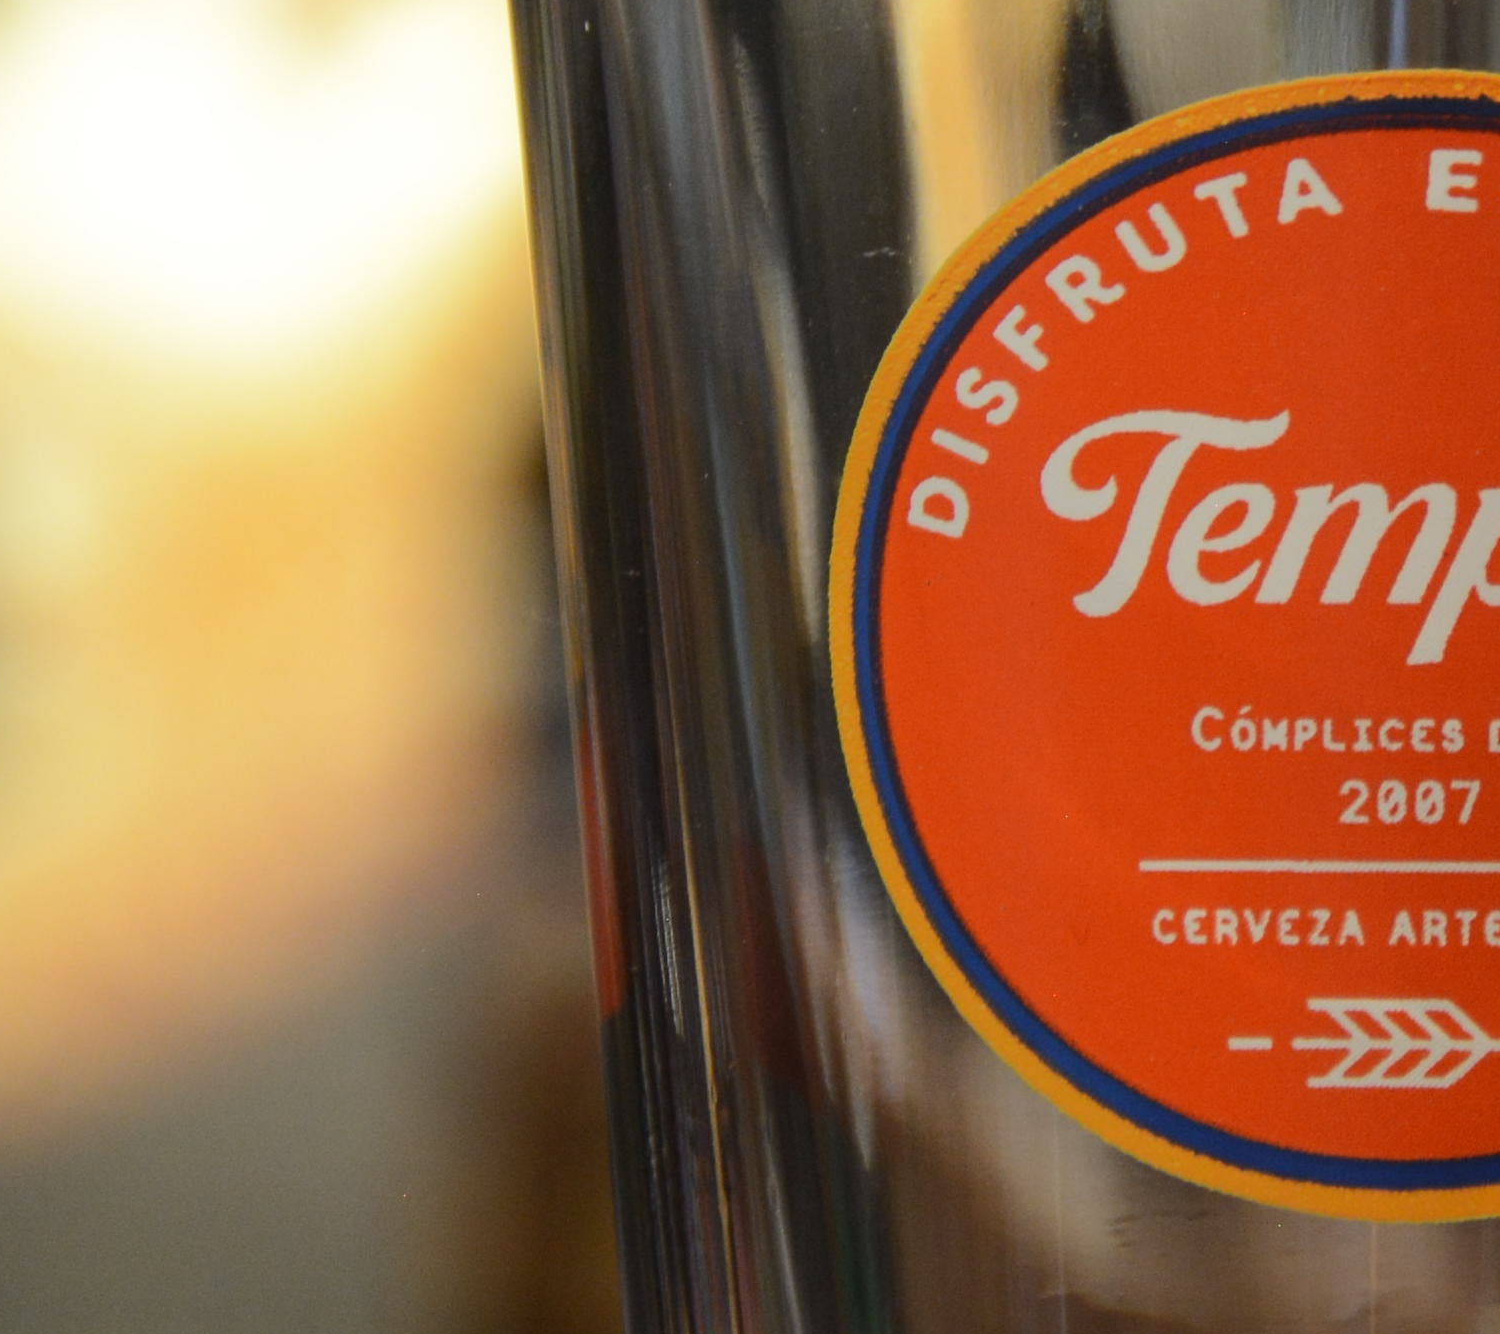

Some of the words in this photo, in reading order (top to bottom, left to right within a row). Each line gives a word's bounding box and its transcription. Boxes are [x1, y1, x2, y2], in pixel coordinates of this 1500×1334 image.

[906, 157, 1343, 539] DISFRUTA
[1339, 779, 1482, 825] 2007
[1152, 907, 1365, 946] CERVEZA
